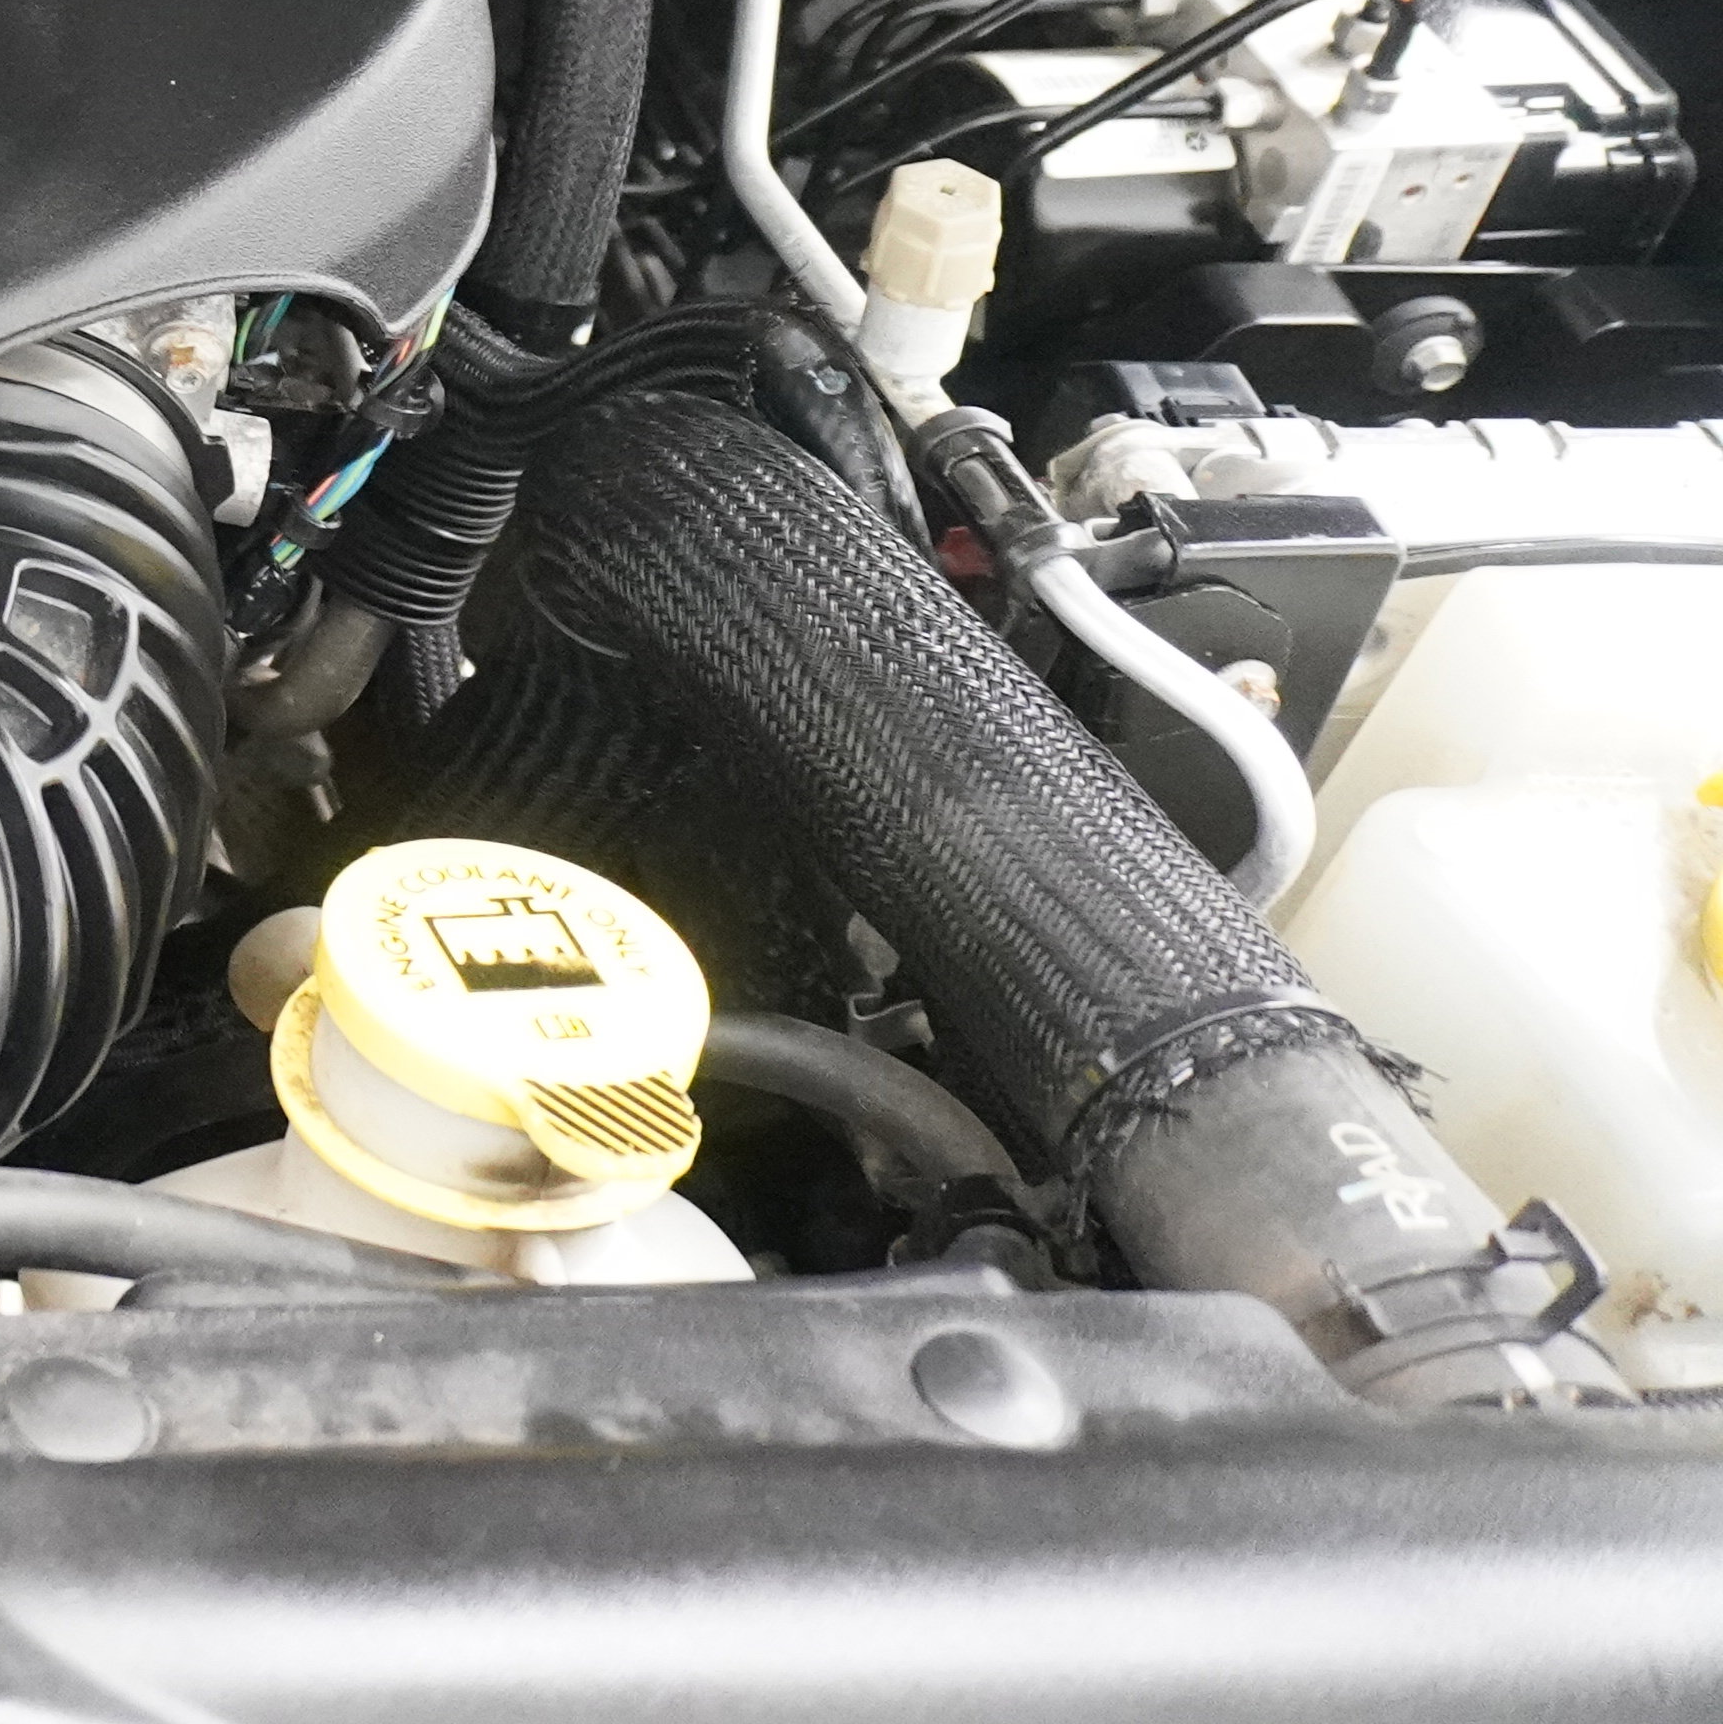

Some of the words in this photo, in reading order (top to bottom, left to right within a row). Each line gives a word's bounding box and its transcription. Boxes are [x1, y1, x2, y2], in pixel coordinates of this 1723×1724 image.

[399, 864, 575, 900] COOLANT
[375, 894, 437, 992] ENGINE
[586, 907, 651, 977] ONLY
